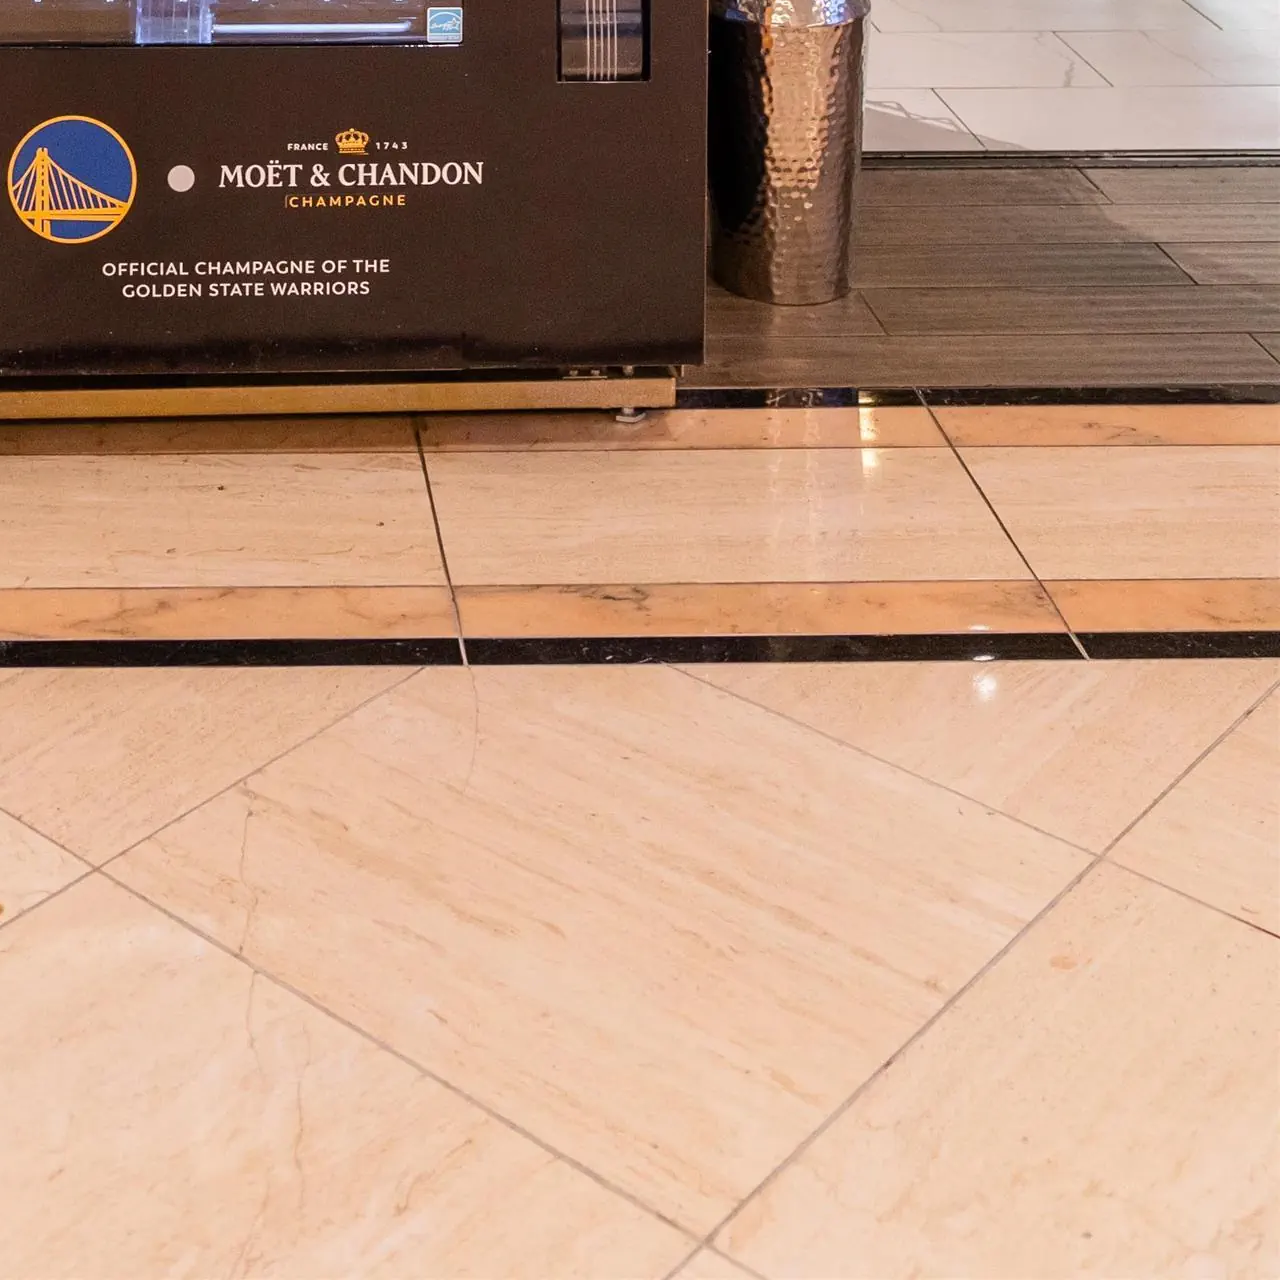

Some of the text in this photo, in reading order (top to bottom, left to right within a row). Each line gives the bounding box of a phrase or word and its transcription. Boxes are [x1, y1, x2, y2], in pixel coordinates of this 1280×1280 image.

[287, 141, 408, 151] FRANCE 1743
[218, 159, 484, 188] MOËT & CHANDON
[289, 194, 406, 208] CHAMPAGNE
[102, 259, 390, 277] OFFICIAL CHAMPAGNE OF THE
[122, 281, 370, 298] GOLDEN STATE WARRIORS
